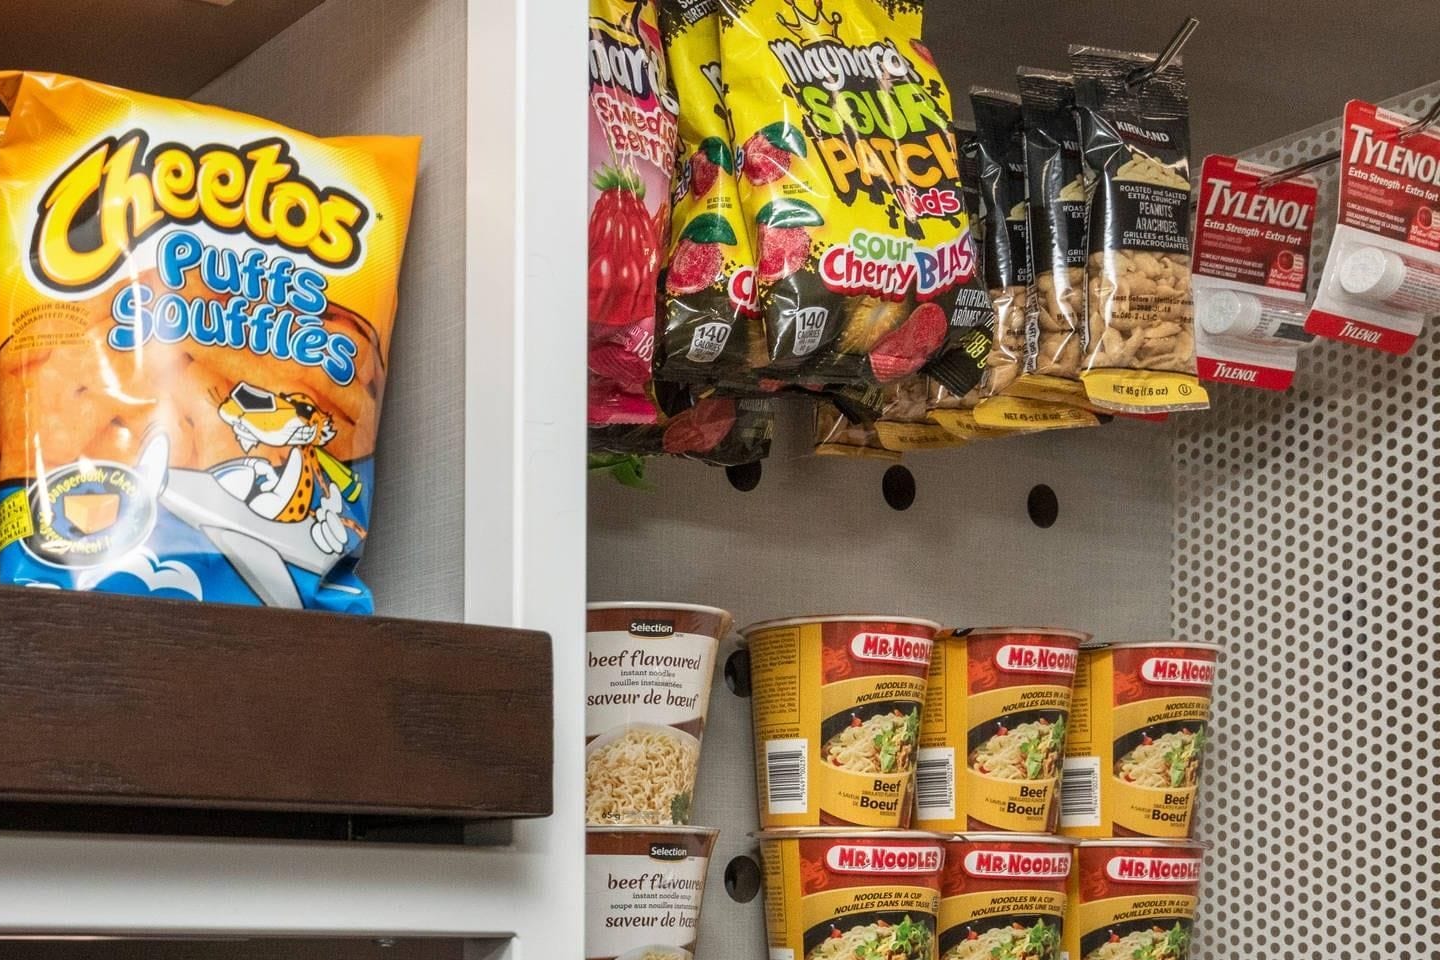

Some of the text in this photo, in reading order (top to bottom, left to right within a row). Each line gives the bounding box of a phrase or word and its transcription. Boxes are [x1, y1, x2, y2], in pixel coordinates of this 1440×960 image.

[802, 82, 948, 140] SOUR
[1115, 121, 1170, 143] KIRKLAND
[1347, 167, 1368, 180] Extra
[1368, 172, 1401, 190] Strength
[1405, 184, 1424, 198] Extra
[1424, 189, 1439, 202] fort
[1119, 185, 1188, 201] ROASTED SALTED
[1127, 193, 1182, 206] EXTRA CRUNCHY
[38, 132, 364, 288] Cheetos
[1139, 202, 1173, 218] PEANUTS
[1204, 177, 1312, 232] TYLENOL
[1135, 218, 1178, 234] ARACHIDES
[1203, 219, 1225, 230] Extra
[1225, 222, 1260, 238] Strength
[1264, 231, 1286, 243] Extra
[1286, 234, 1302, 246] fort
[158, 231, 328, 315] Puffs
[822, 247, 916, 290] Cherry
[799, 310, 826, 329] 140
[697, 326, 729, 343] 140
[1337, 321, 1383, 344] TYLENOL
[1213, 363, 1258, 382] TYLENOL
[1112, 384, 1123, 394] NET
[630, 622, 673, 634] Selection
[588, 649, 702, 671] beef flavoured
[620, 669, 676, 678] instant noodles
[610, 679, 639, 687] nouilles
[875, 681, 908, 691] NOODLES
[586, 692, 640, 707] saveur
[643, 687, 662, 705] de
[855, 690, 911, 703] NOUILLES DANS
[1020, 692, 1053, 700] NOODLES
[1001, 699, 1056, 713] NOUILLES DANS
[1165, 702, 1196, 711] NOODLES
[1146, 711, 1182, 723] NOUILLES
[873, 779, 901, 792] Beef
[1019, 786, 1048, 798] Beef
[860, 796, 899, 811] Boeuf
[1164, 793, 1189, 805] Beef
[1006, 802, 1045, 816] Boeuf
[1151, 810, 1187, 822] Boeuf
[650, 846, 687, 857] Selection
[871, 848, 938, 869] NOODLES
[1007, 855, 1069, 875] NOODLES
[607, 873, 649, 891] beef
[658, 892, 679, 900] noodle
[853, 891, 893, 902] NOODLES
[910, 892, 923, 900] CUP
[990, 896, 1028, 905] NOODLES
[610, 903, 632, 911] soupe
[833, 901, 875, 915] NOUILLES
[876, 900, 899, 909] DANS
[900, 900, 914, 908] UNE
[970, 904, 1010, 917] NOUILLES
[1012, 903, 1034, 911] DANS
[1132, 900, 1167, 909] NOODLES
[605, 911, 675, 929] saveur de
[1112, 907, 1172, 921] NOUILLES DANS
